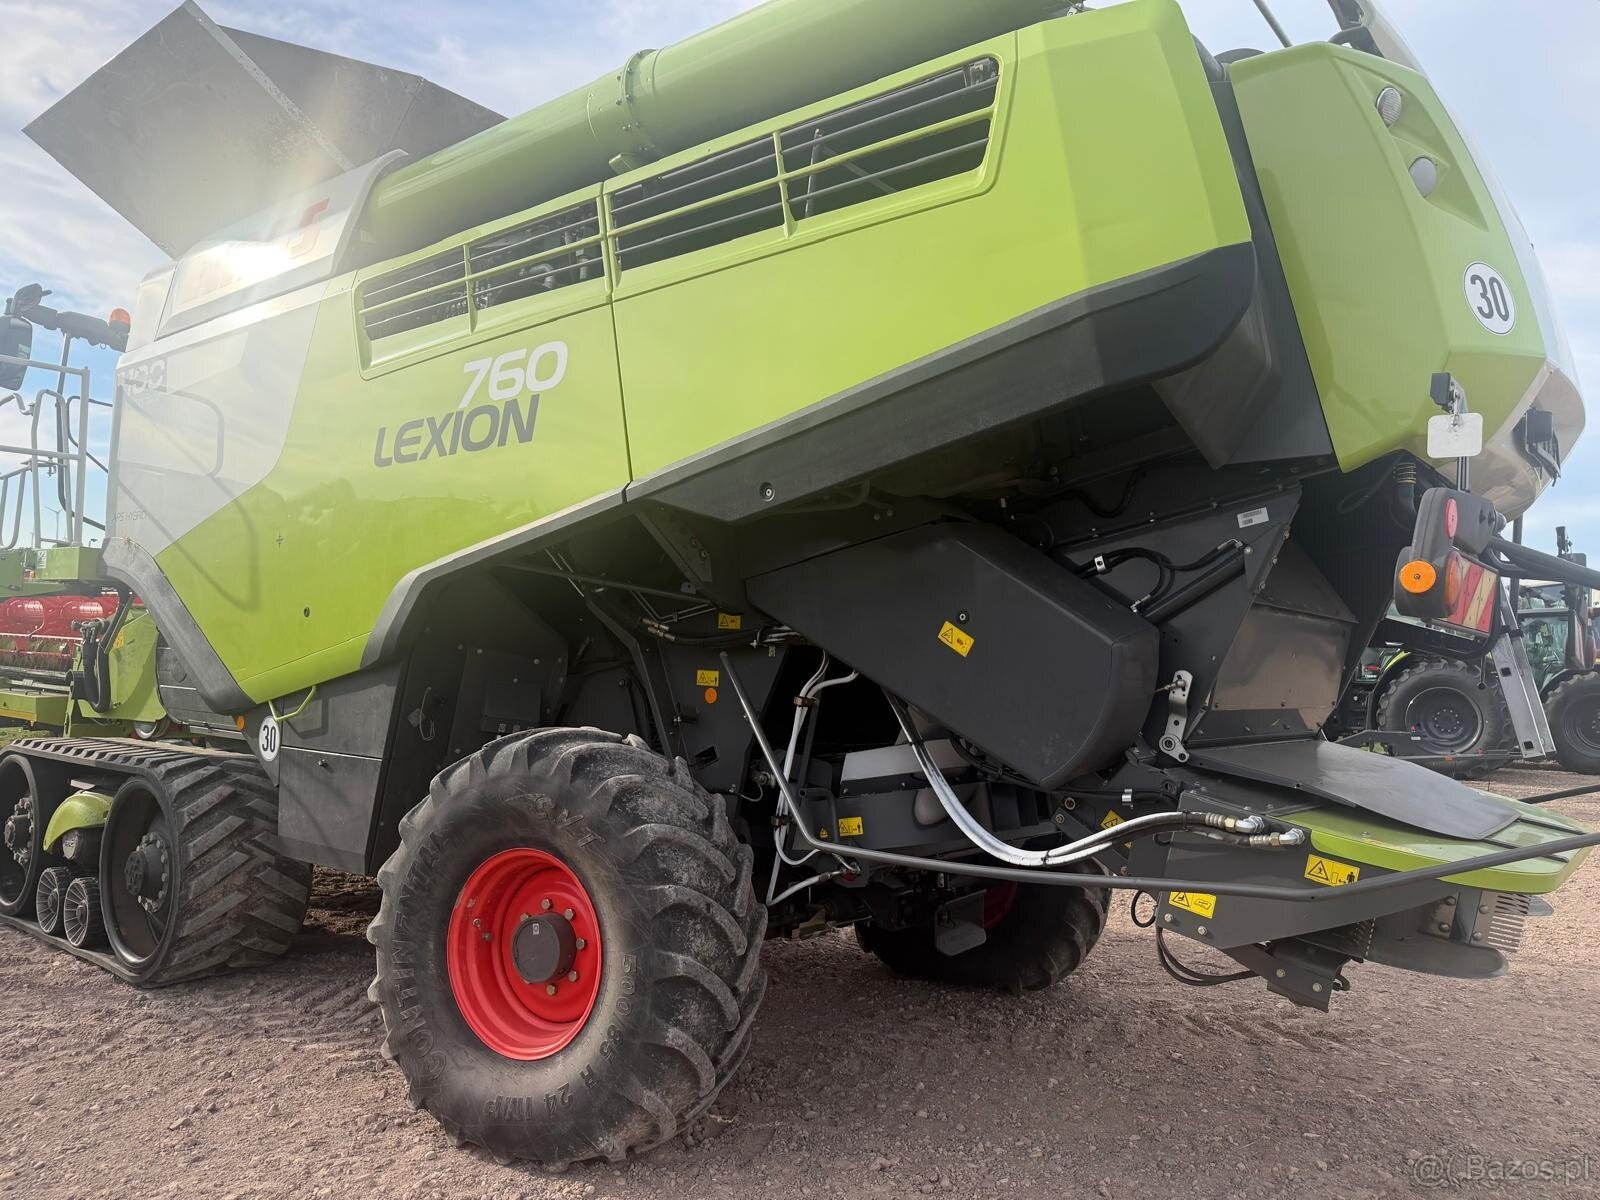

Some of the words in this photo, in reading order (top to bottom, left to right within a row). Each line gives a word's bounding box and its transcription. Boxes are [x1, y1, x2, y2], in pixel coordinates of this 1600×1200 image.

[1470, 274, 1510, 321] 30
[458, 341, 569, 409] 760
[374, 393, 540, 468] LEXION
[262, 724, 277, 752] 30
[543, 1082, 573, 1114] 24
